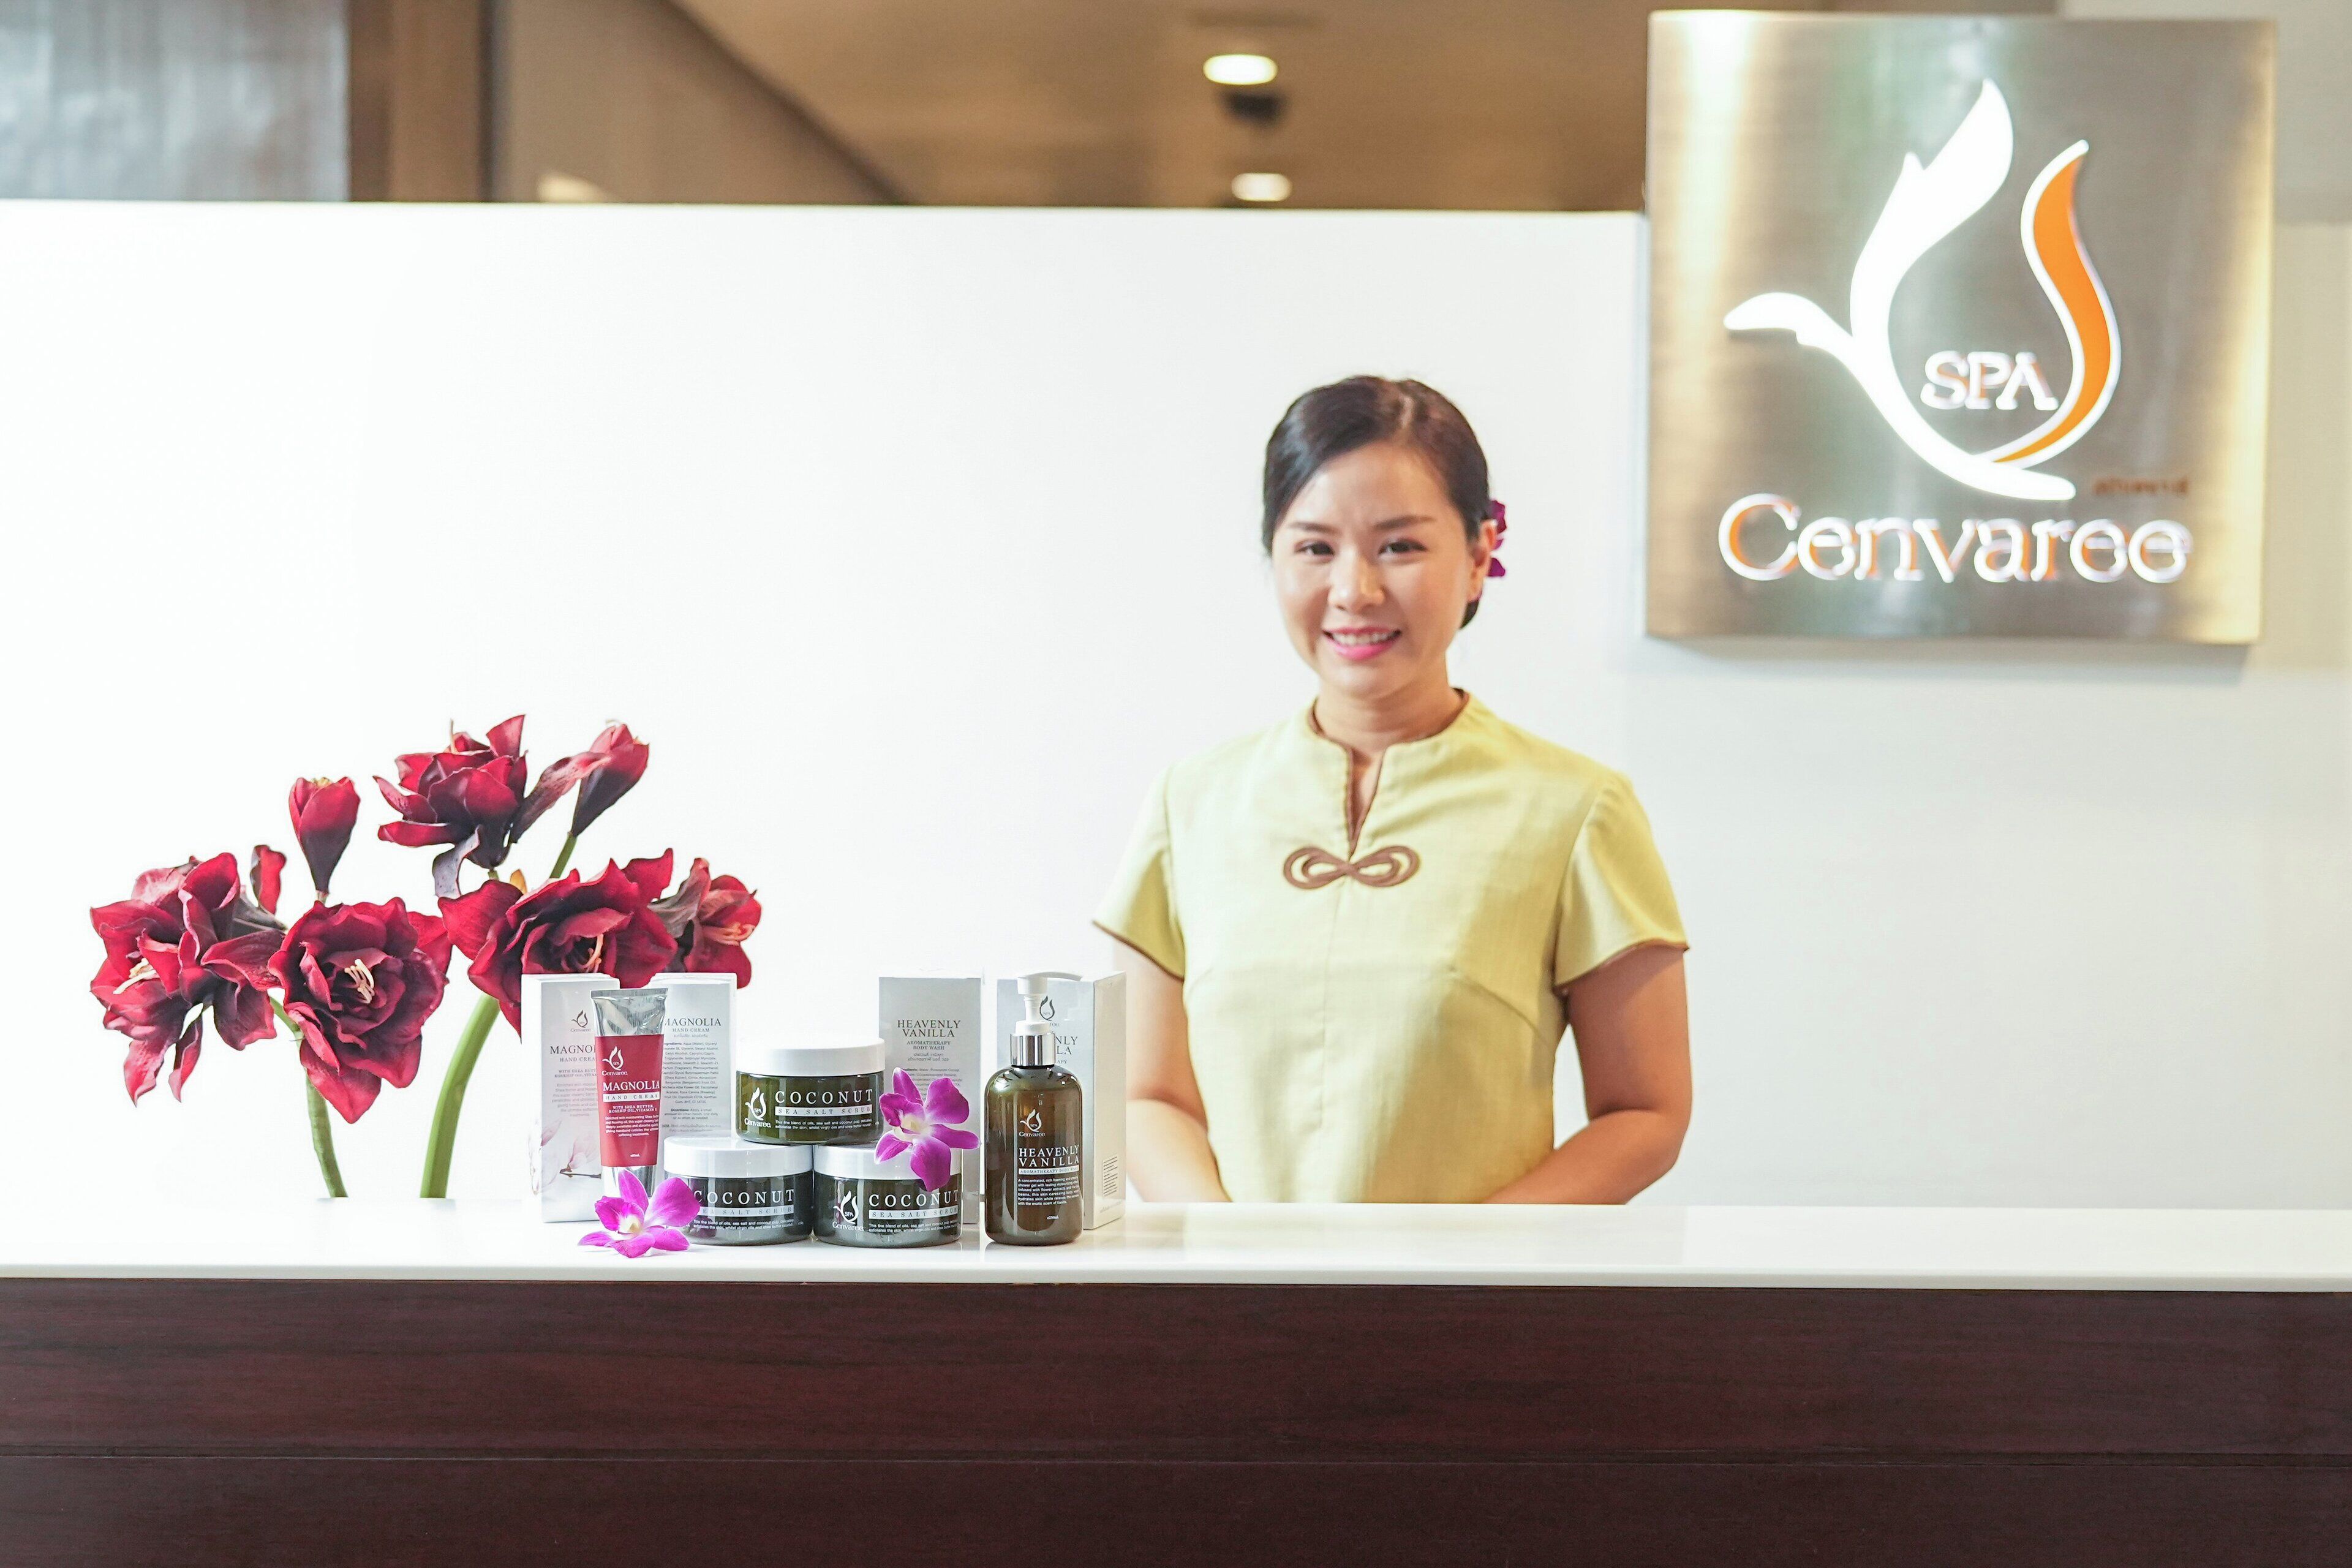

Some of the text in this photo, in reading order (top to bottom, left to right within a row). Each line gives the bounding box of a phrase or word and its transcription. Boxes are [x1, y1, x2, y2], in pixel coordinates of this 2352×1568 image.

[1920, 350, 2059, 410] SPA
[1719, 493, 2192, 582] Cenvaree
[897, 1020, 961, 1028] HEAVENLY
[603, 1080, 660, 1091] MAGNOLIA
[775, 1089, 873, 1104] COCONUT
[1019, 1144, 1079, 1157] HEAVENLY
[1019, 1155, 1079, 1167] VANILLA
[693, 1189, 794, 1205] COCONUT
[869, 1189, 959, 1207] COCONUT
